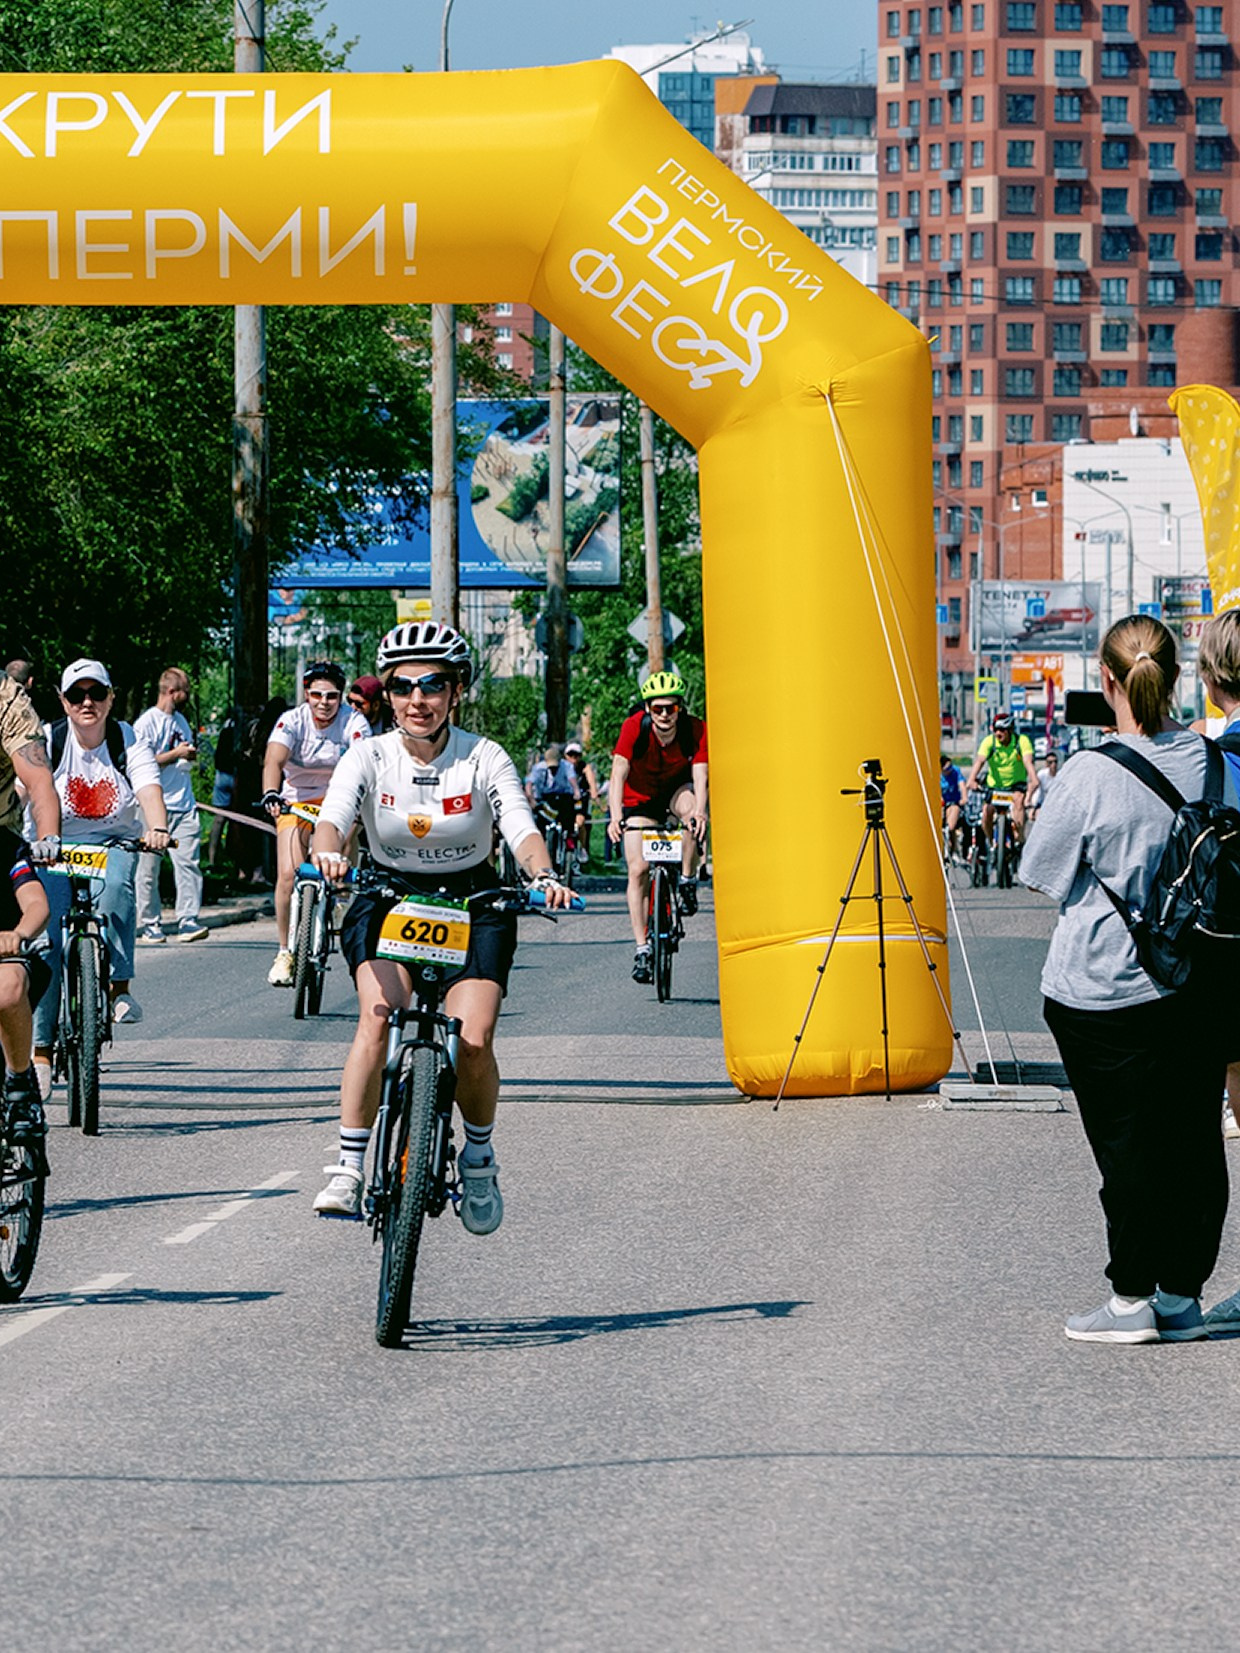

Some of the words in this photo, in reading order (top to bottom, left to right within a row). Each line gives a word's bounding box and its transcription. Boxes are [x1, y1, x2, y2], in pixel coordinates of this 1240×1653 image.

[656, 157, 825, 302] ПЕРМСКИЙ
[417, 843, 477, 860] ELECTRA
[651, 841, 673, 852] 075
[401, 919, 449, 946] 620
